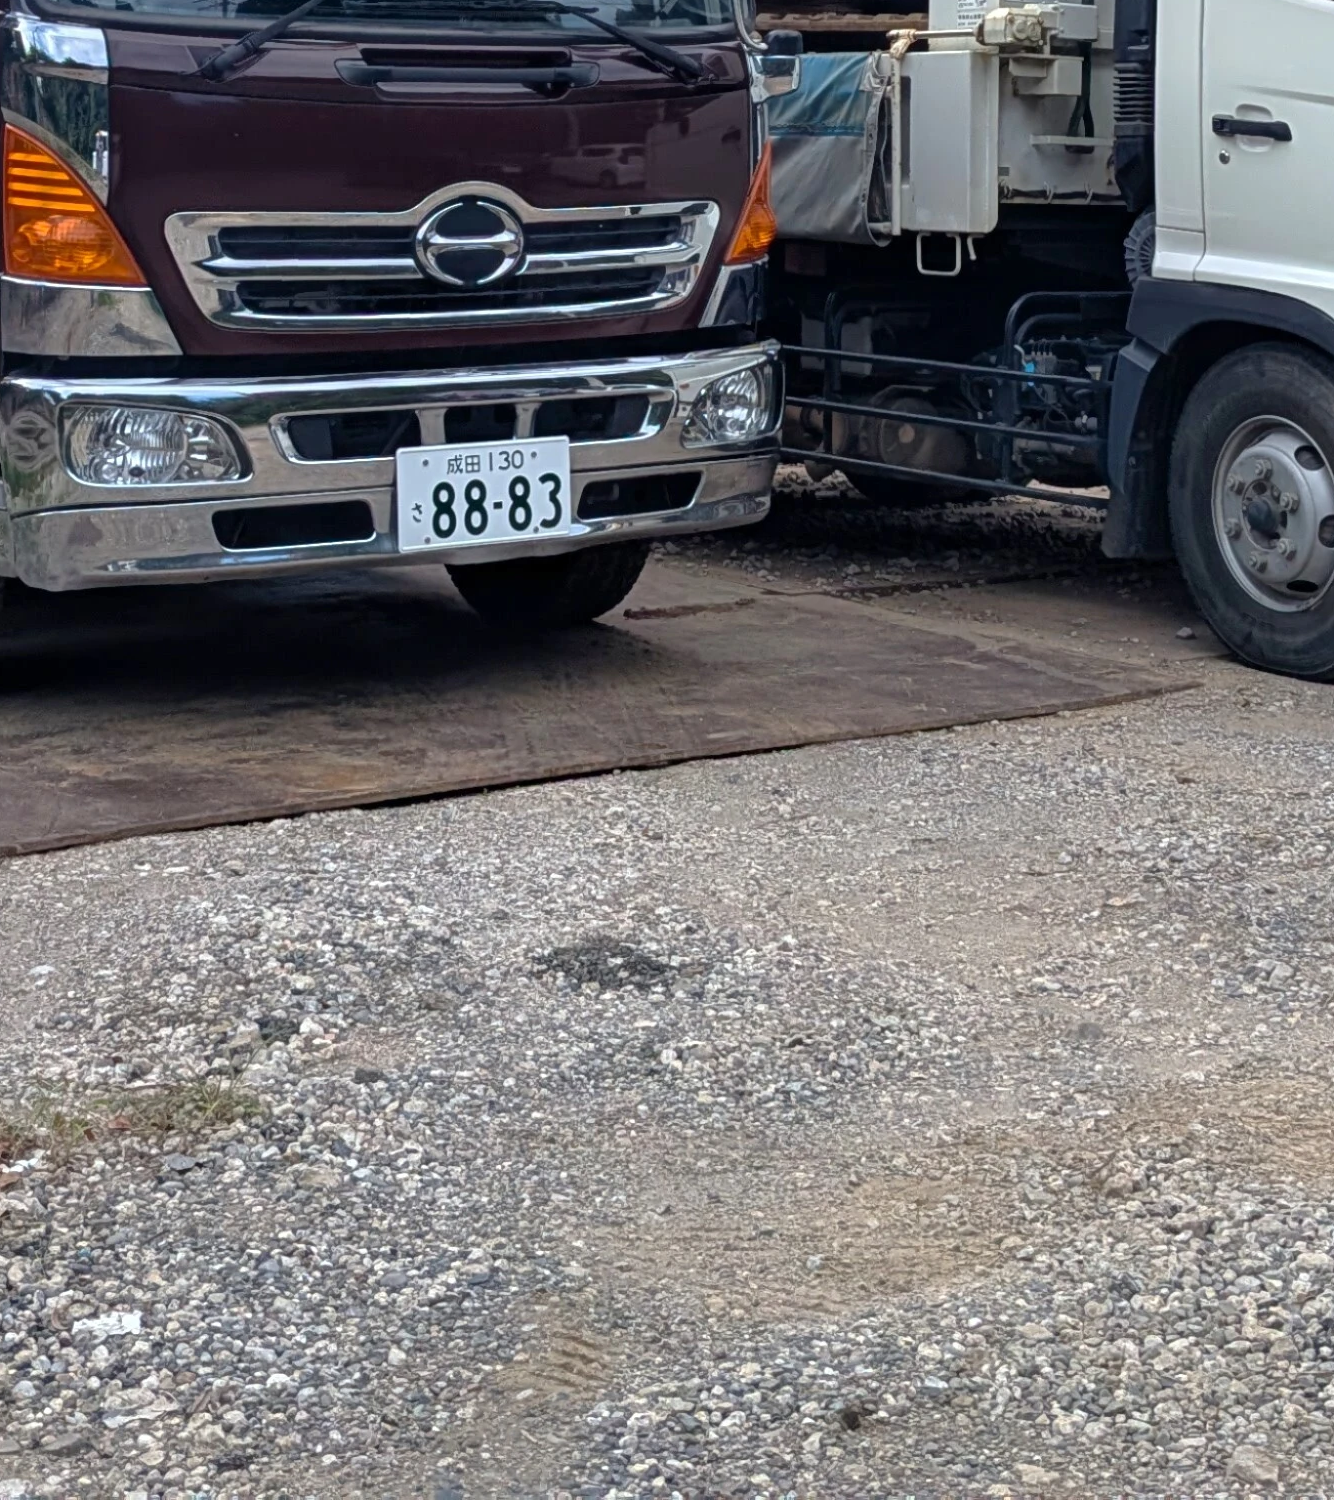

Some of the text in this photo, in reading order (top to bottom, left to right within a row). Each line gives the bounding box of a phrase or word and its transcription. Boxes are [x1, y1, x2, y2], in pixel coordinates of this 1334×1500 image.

[447, 450, 524, 475] 成田 130
[411, 472, 562, 539] さ 88-83
